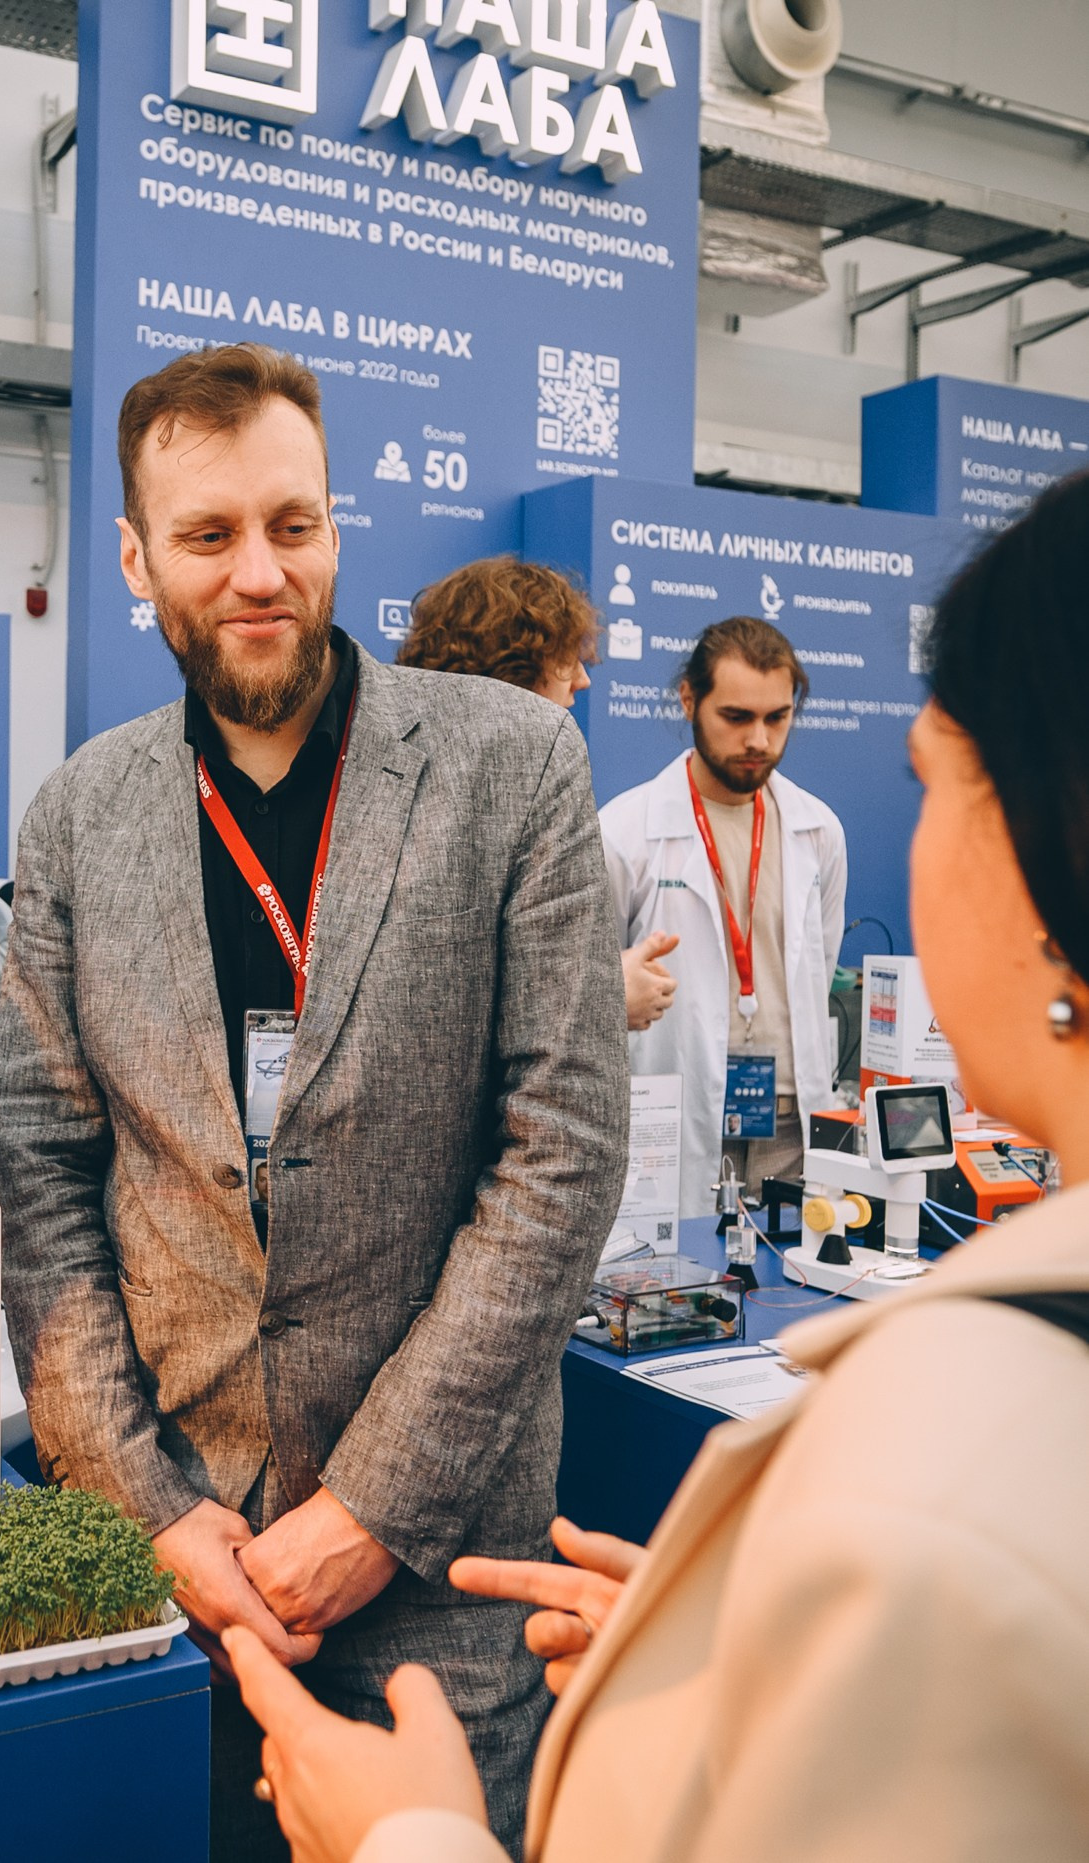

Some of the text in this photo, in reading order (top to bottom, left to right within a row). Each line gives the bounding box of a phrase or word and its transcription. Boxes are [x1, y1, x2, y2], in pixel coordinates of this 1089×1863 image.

[366, 35, 643, 177] ЛАБА
[140, 93, 647, 227] Сервис по поиску и подбору научного
[140, 137, 674, 270] оборудования и расходных материалов,
[139, 177, 623, 290] произведенных в России и Беларуси
[138, 277, 473, 360] НАША ЛАБА В ЦИФРАХ
[137, 324, 203, 352] Проект
[308, 354, 355, 377] июне
[359, 359, 398, 383] 2022
[399, 369, 440, 389] года
[422, 424, 466, 445] более
[961, 415, 1014, 445] НАША
[1017, 425, 1064, 453] ЛАБА
[422, 450, 468, 491] 50
[961, 457, 1023, 484] Каталог
[421, 502, 484, 521] регионов
[611, 518, 914, 578] СИСТЕМА ЛИЧНЫХ КАБИНЕТОВ
[651, 580, 718, 600] ПОКУПАТЕЛЬ
[610, 680, 660, 701] Запрос
[847, 700, 881, 716] через
[610, 704, 652, 720] НАША
[253, 1138, 270, 1149] 202
